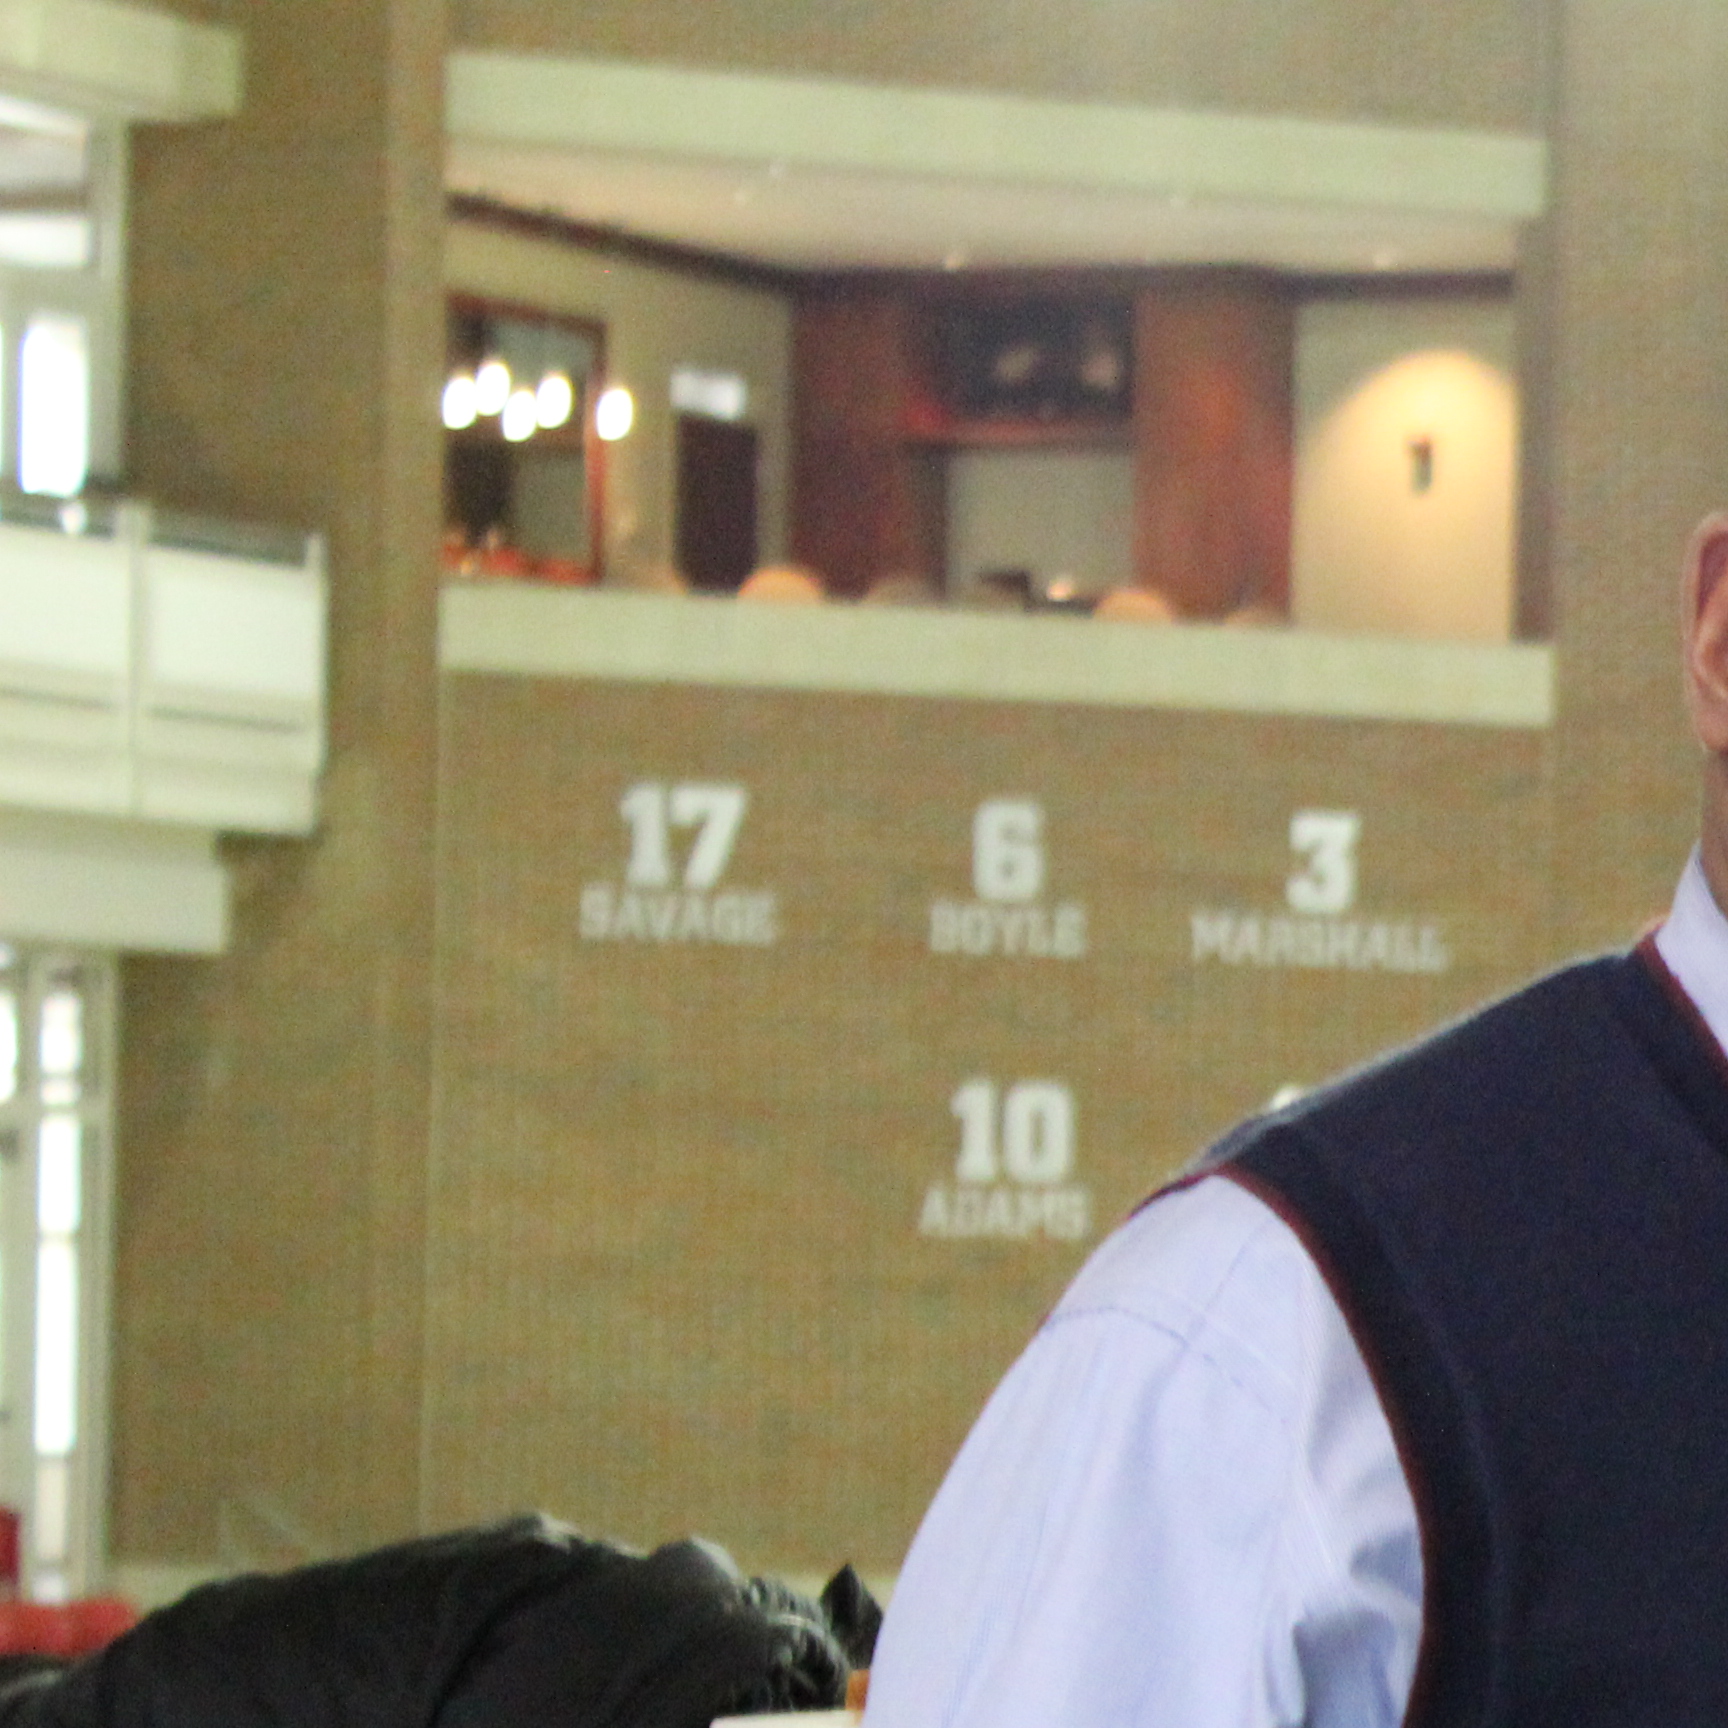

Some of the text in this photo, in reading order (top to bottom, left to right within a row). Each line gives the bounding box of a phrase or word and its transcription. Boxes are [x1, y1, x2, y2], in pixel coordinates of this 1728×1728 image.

[618, 780, 746, 888] 17
[973, 798, 1045, 900] 6
[1286, 810, 1362, 913] 3
[1190, 907, 1448, 973] MARSHALL
[950, 1077, 1074, 1180] 10
